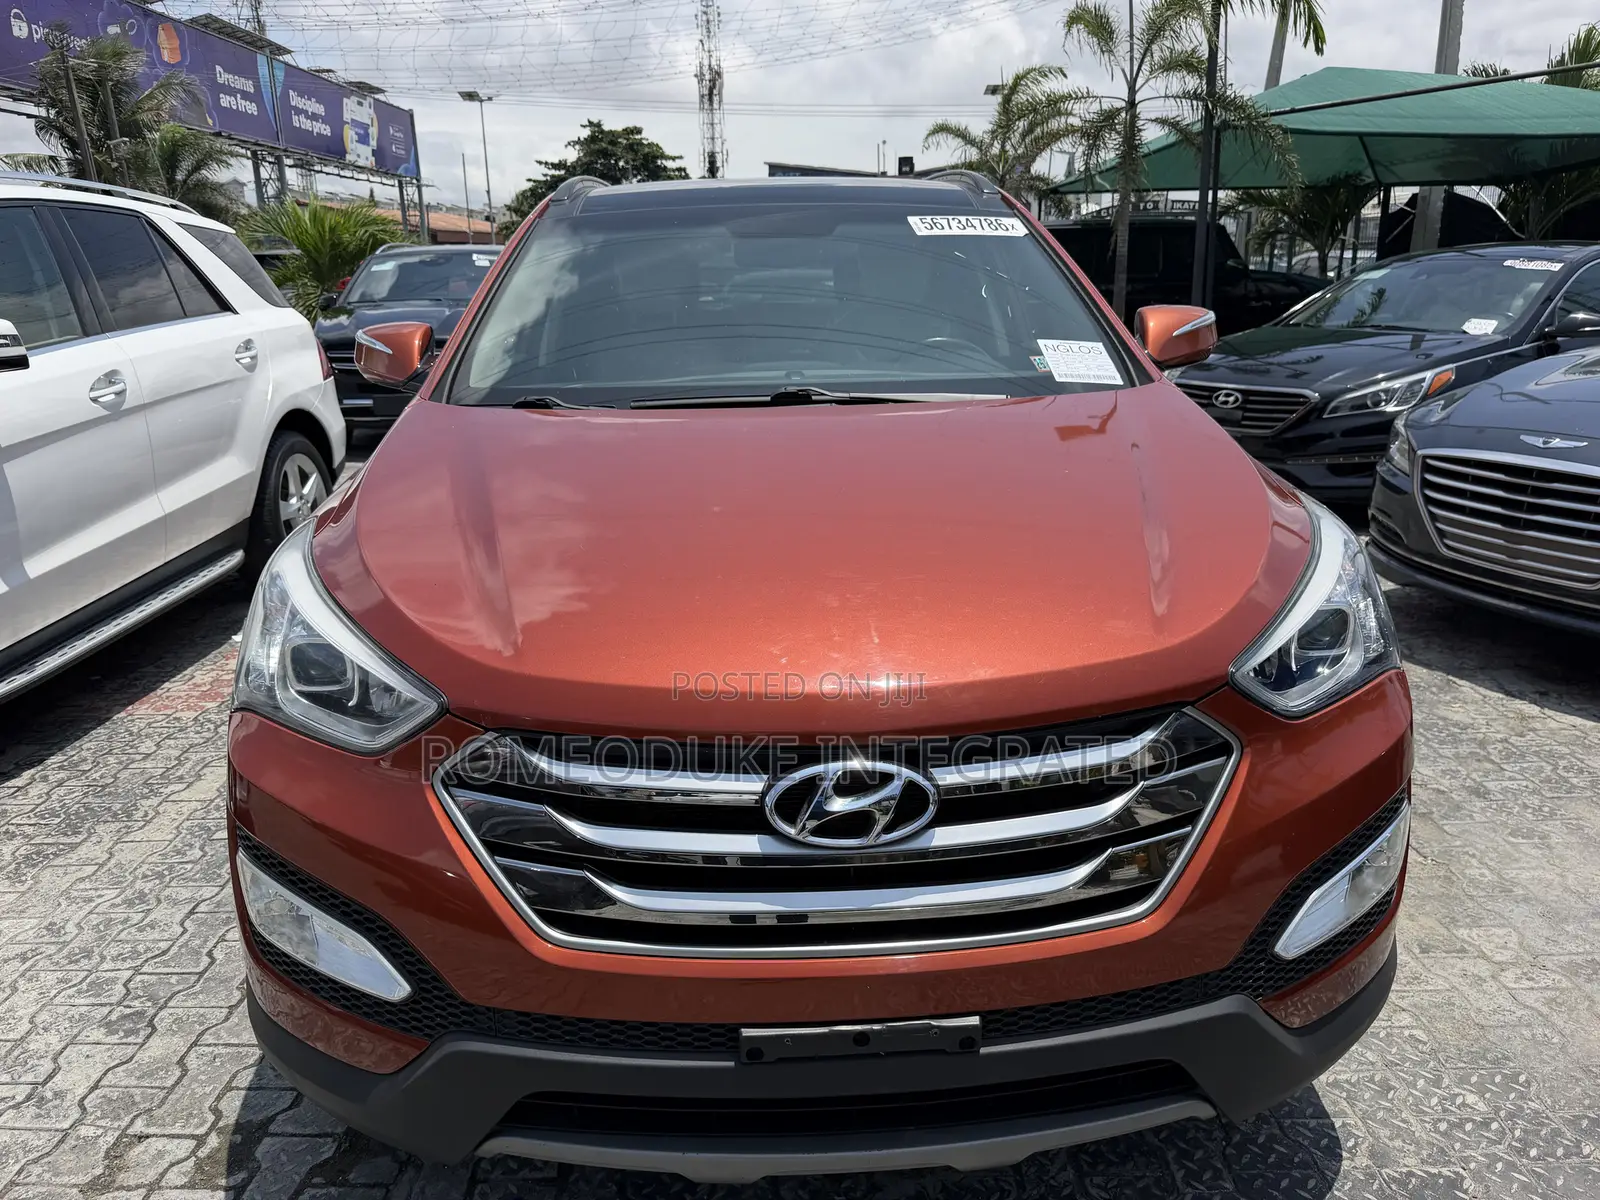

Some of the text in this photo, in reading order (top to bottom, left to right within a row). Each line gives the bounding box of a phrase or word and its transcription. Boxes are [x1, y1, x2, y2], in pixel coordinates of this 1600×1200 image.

[215, 65, 255, 94] Dreams
[219, 93, 258, 116] are free
[289, 89, 326, 117] Discipline
[291, 110, 332, 137] is the price
[1044, 344, 1103, 355] NGLOS
